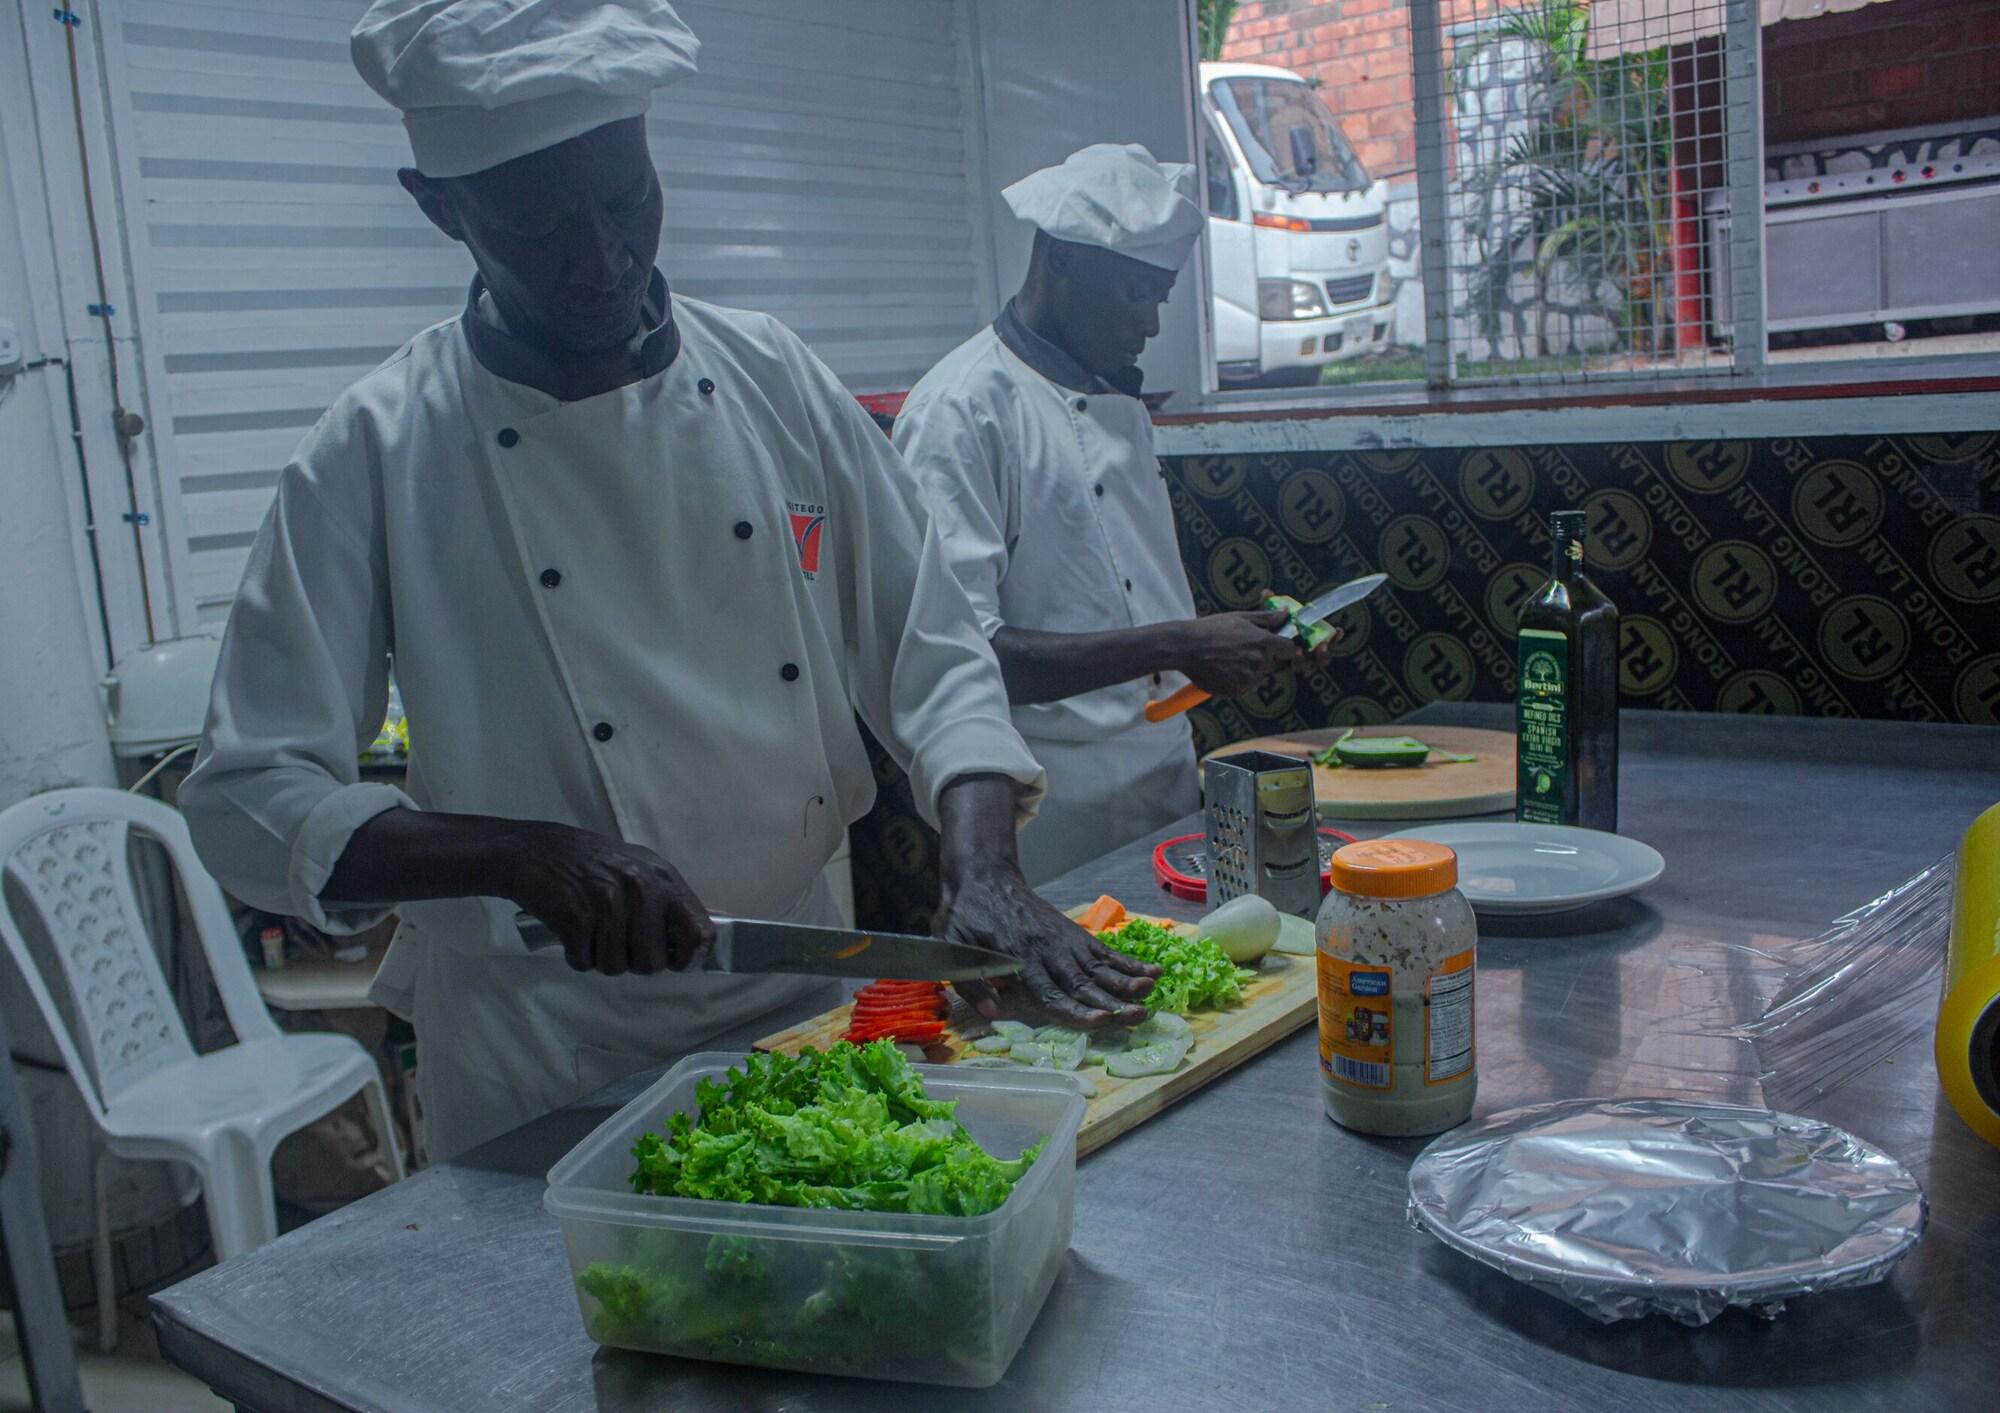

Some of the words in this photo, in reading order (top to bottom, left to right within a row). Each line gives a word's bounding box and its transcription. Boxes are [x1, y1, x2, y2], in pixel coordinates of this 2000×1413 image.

[1478, 453, 1521, 507] RL
[1771, 440, 1810, 473] RO
[1232, 491, 1268, 535] LAN
[1295, 481, 1333, 531] RL
[1337, 465, 1391, 526] RONG
[1406, 464, 1447, 512] LAN
[1728, 486, 1776, 536] LAN
[1814, 471, 1867, 533] RL
[1877, 454, 1948, 527] RONG
[1173, 490, 1219, 549] RONG
[1442, 510, 1500, 575] RONG
[1591, 500, 1638, 558] RL
[1645, 484, 1708, 552] RONG
[1223, 548, 1260, 597] RL
[1264, 534, 1315, 594] RONG
[1397, 526, 1436, 578] RL
[1771, 536, 1835, 607] RONG
[1858, 538, 1911, 592] LAN
[1953, 527, 2000, 590] RL
[1432, 584, 1472, 631] LAN
[1632, 563, 1677, 612] LAN
[1712, 551, 1761, 610] RL
[1618, 625, 1664, 682] RL
[1671, 612, 1733, 680] RONG
[1753, 615, 1802, 668] LAN
[1841, 607, 1893, 667] RL
[1905, 591, 1974, 665] RONG
[1353, 652, 1393, 696] LAN
[1422, 643, 1462, 694] RL
[1524, 679, 1561, 694] Bertini
[1796, 666, 1845, 717] ONG
[1527, 724, 1557, 736] SPANISH
